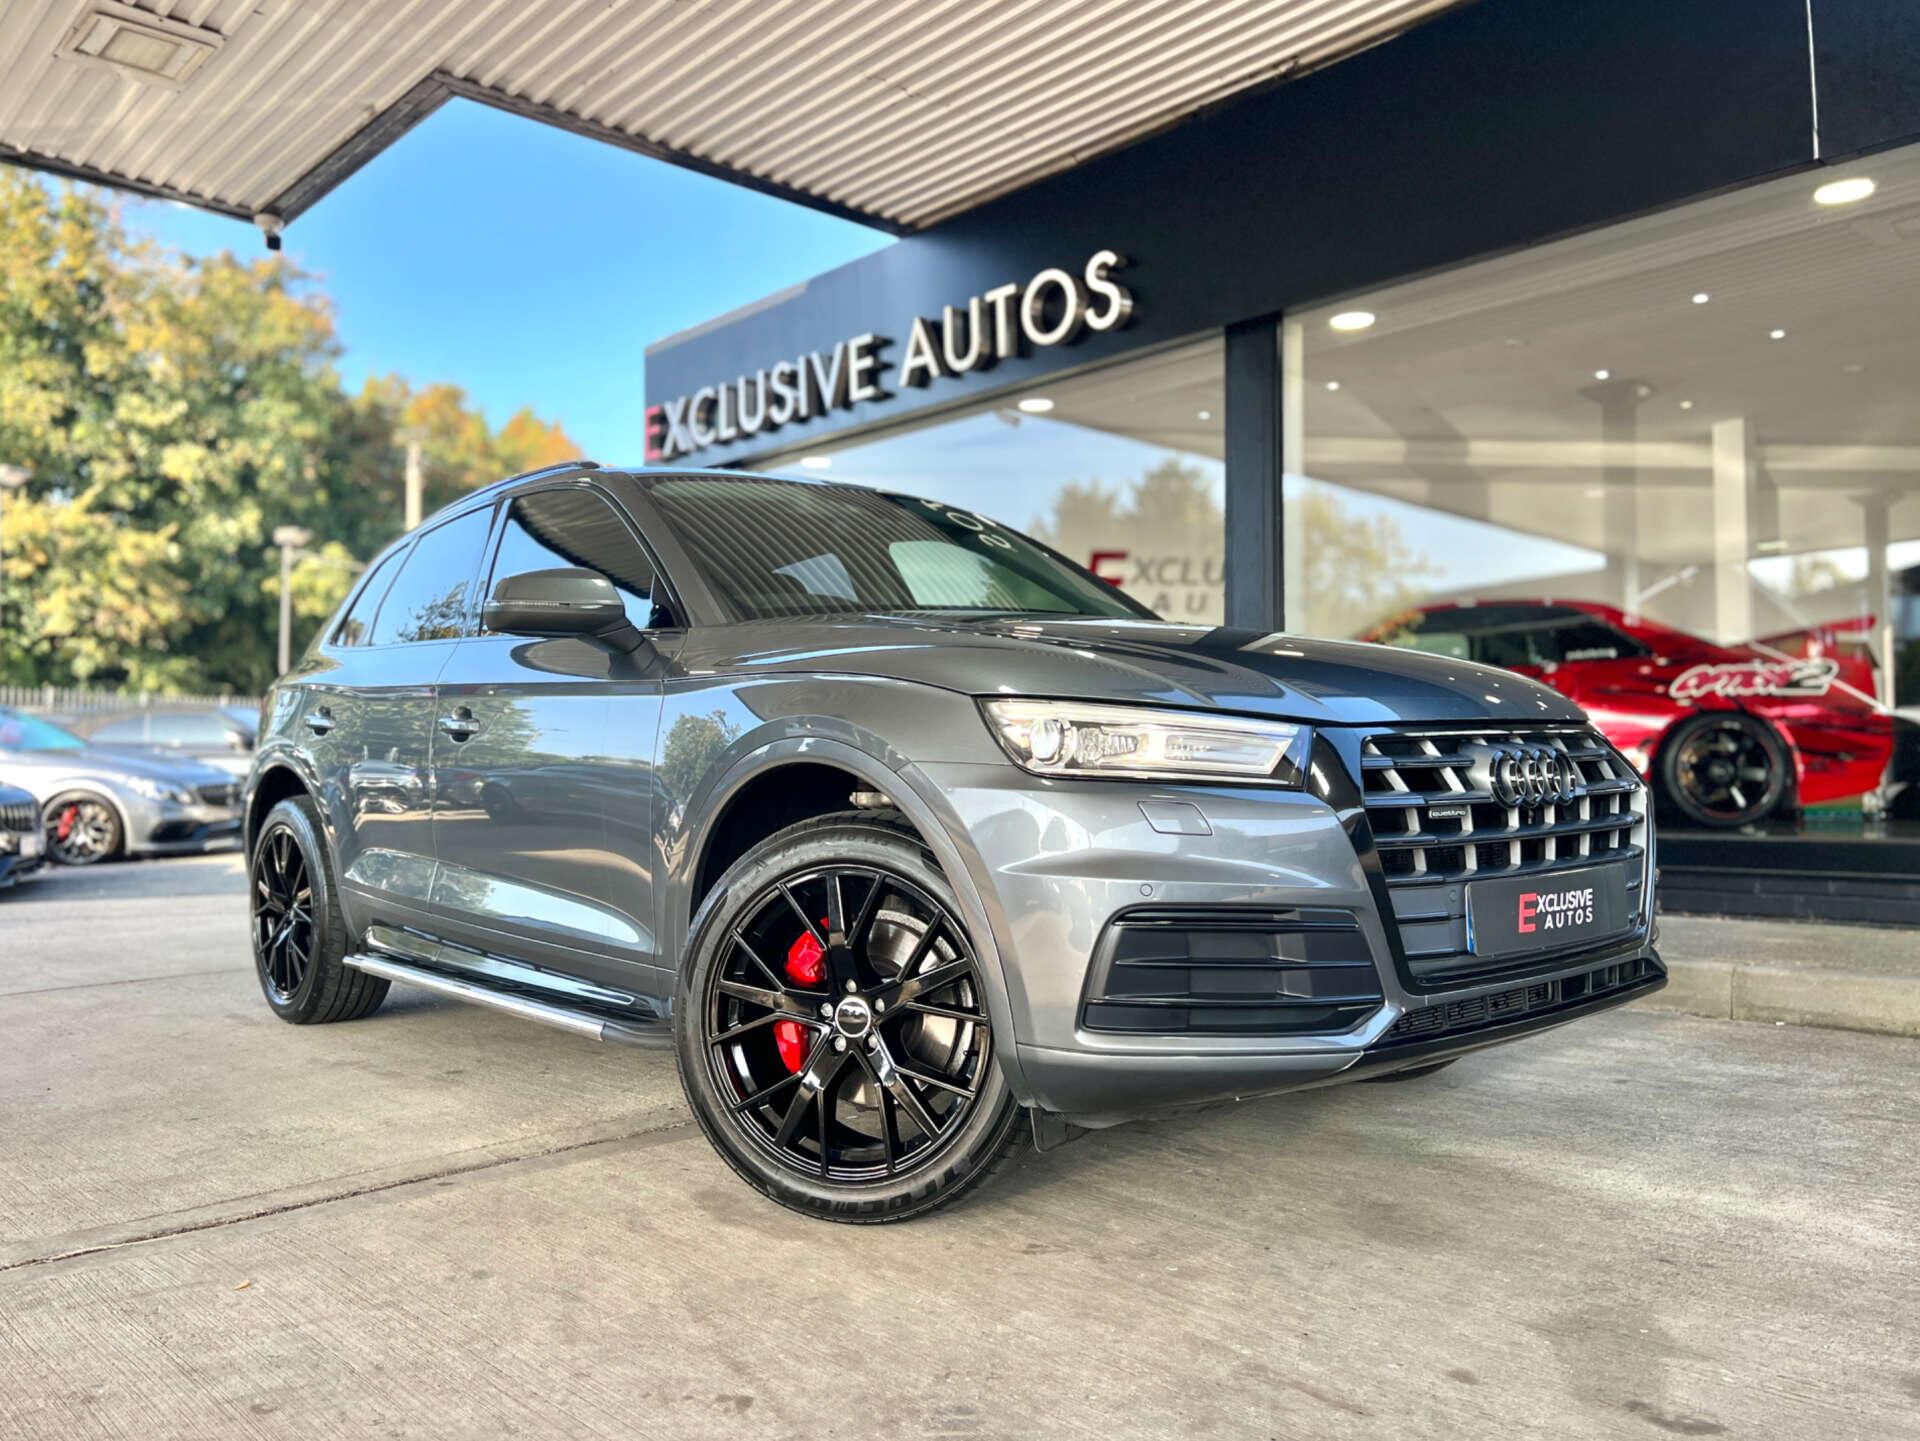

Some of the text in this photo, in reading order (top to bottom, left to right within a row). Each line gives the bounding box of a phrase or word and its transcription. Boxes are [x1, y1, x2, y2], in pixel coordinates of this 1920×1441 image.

[645, 250, 1130, 461] EXCLUSIVE AUTOS
[1519, 888, 1593, 933] EXCLUSIVE
[1544, 907, 1593, 929] AUTOS
